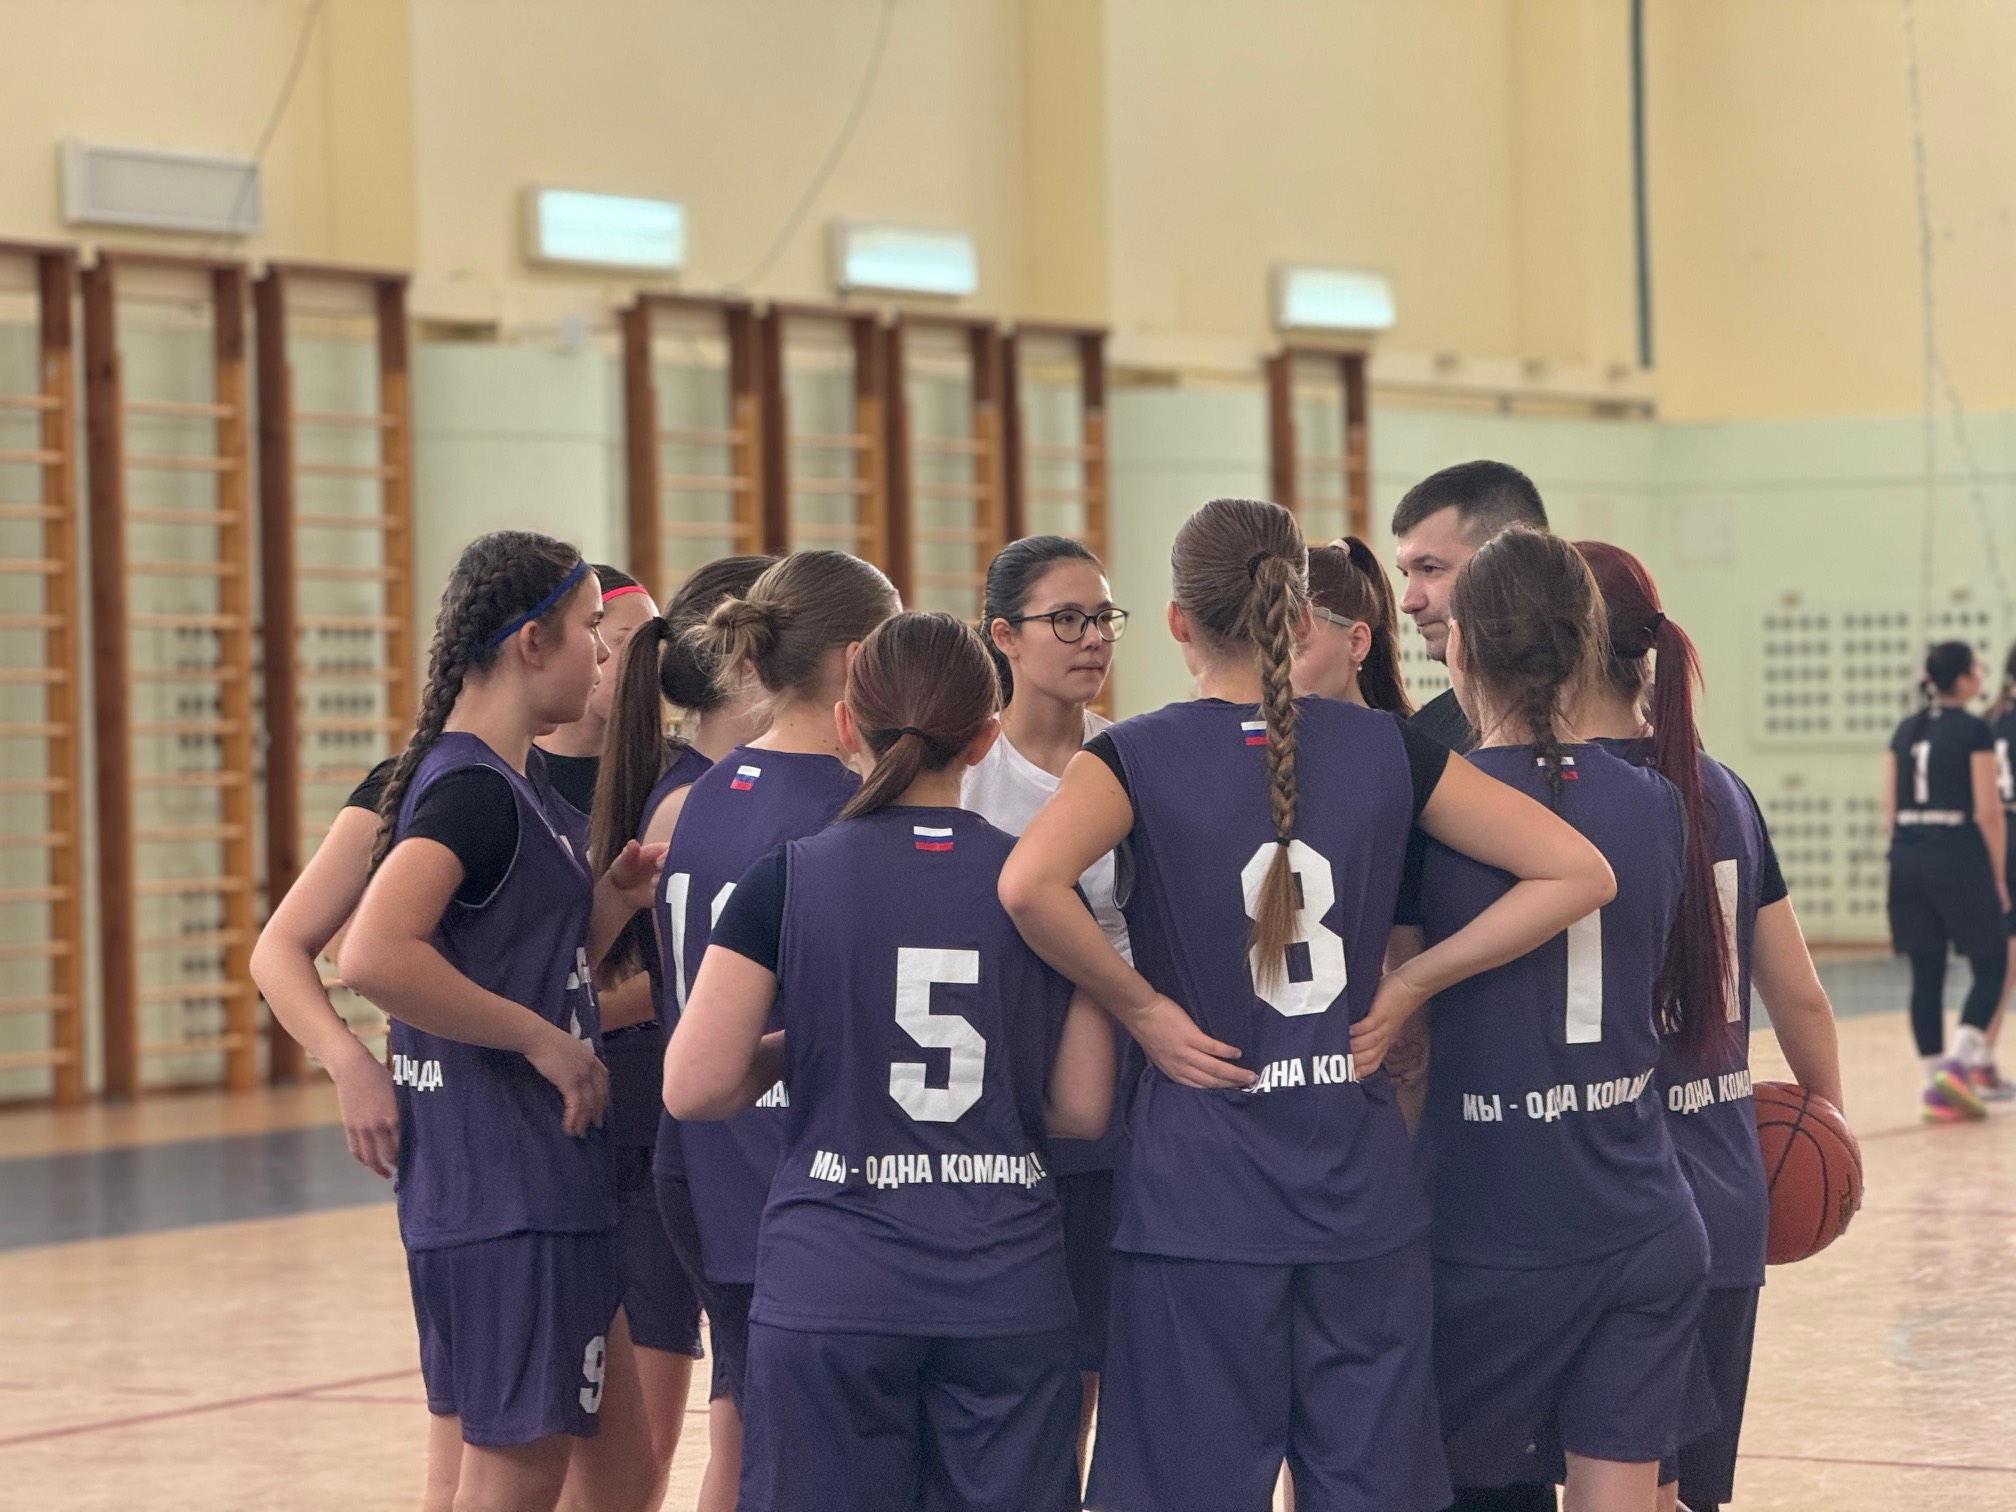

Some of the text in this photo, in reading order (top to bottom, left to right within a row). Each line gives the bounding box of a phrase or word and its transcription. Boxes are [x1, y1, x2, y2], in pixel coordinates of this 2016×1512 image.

[1910, 740, 1932, 804] 1
[1241, 839, 1348, 1017] 8
[889, 947, 987, 1122] 5
[1241, 1057, 1307, 1094] ДНА
[1668, 1078, 1715, 1115] ОДНА
[1462, 1093, 1503, 1122] МЫ
[809, 1150, 847, 1184] МЫ
[865, 1154, 933, 1190] ОДНА
[579, 1335, 607, 1414] 9
